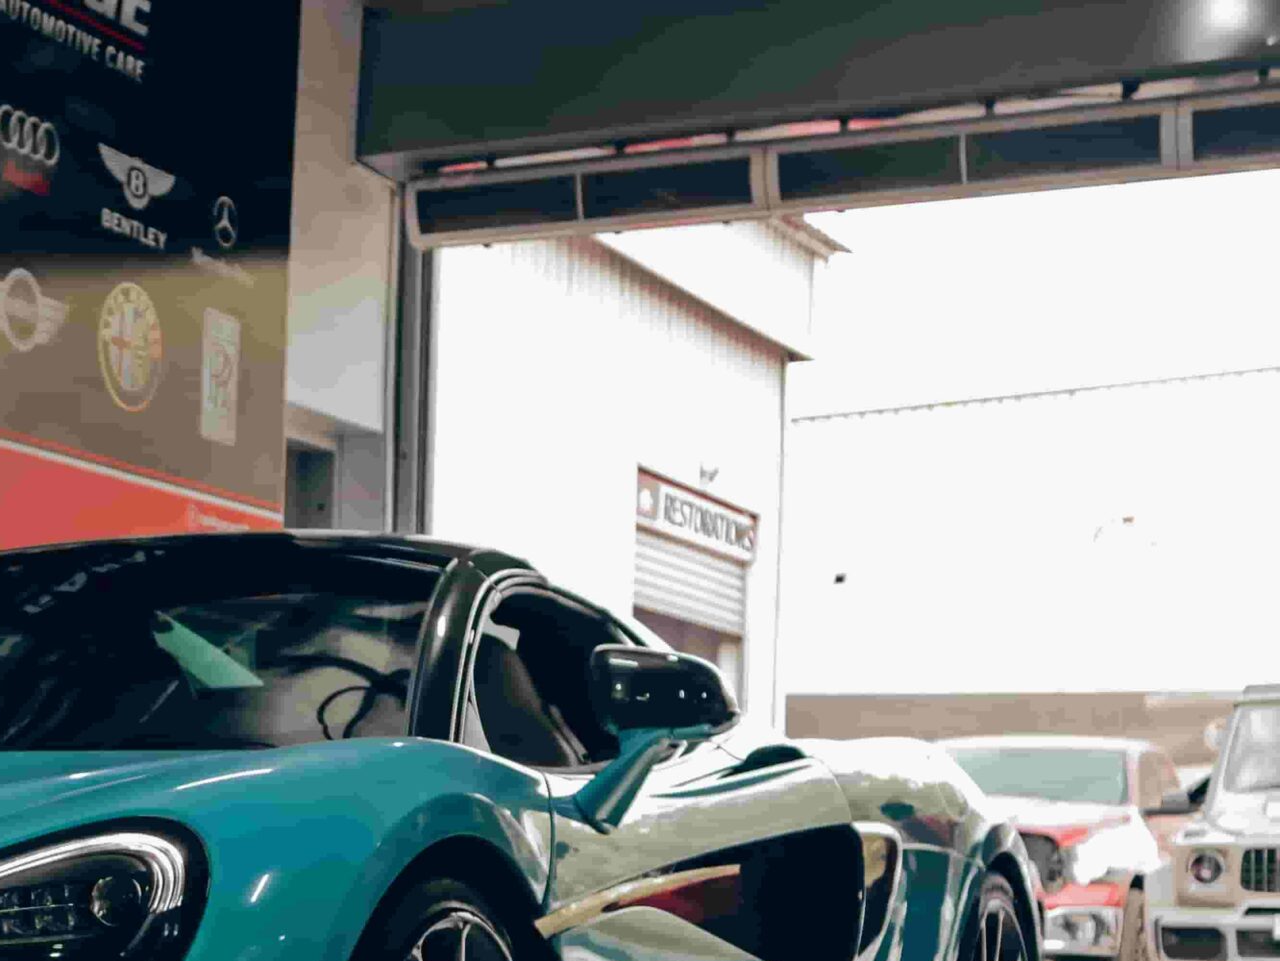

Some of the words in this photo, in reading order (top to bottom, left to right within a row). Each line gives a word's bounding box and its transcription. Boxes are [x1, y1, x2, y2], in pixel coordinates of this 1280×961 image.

[105, 45, 145, 84] CARE
[101, 208, 167, 249] BENTLEY
[664, 492, 754, 552] RESTORATIONS
